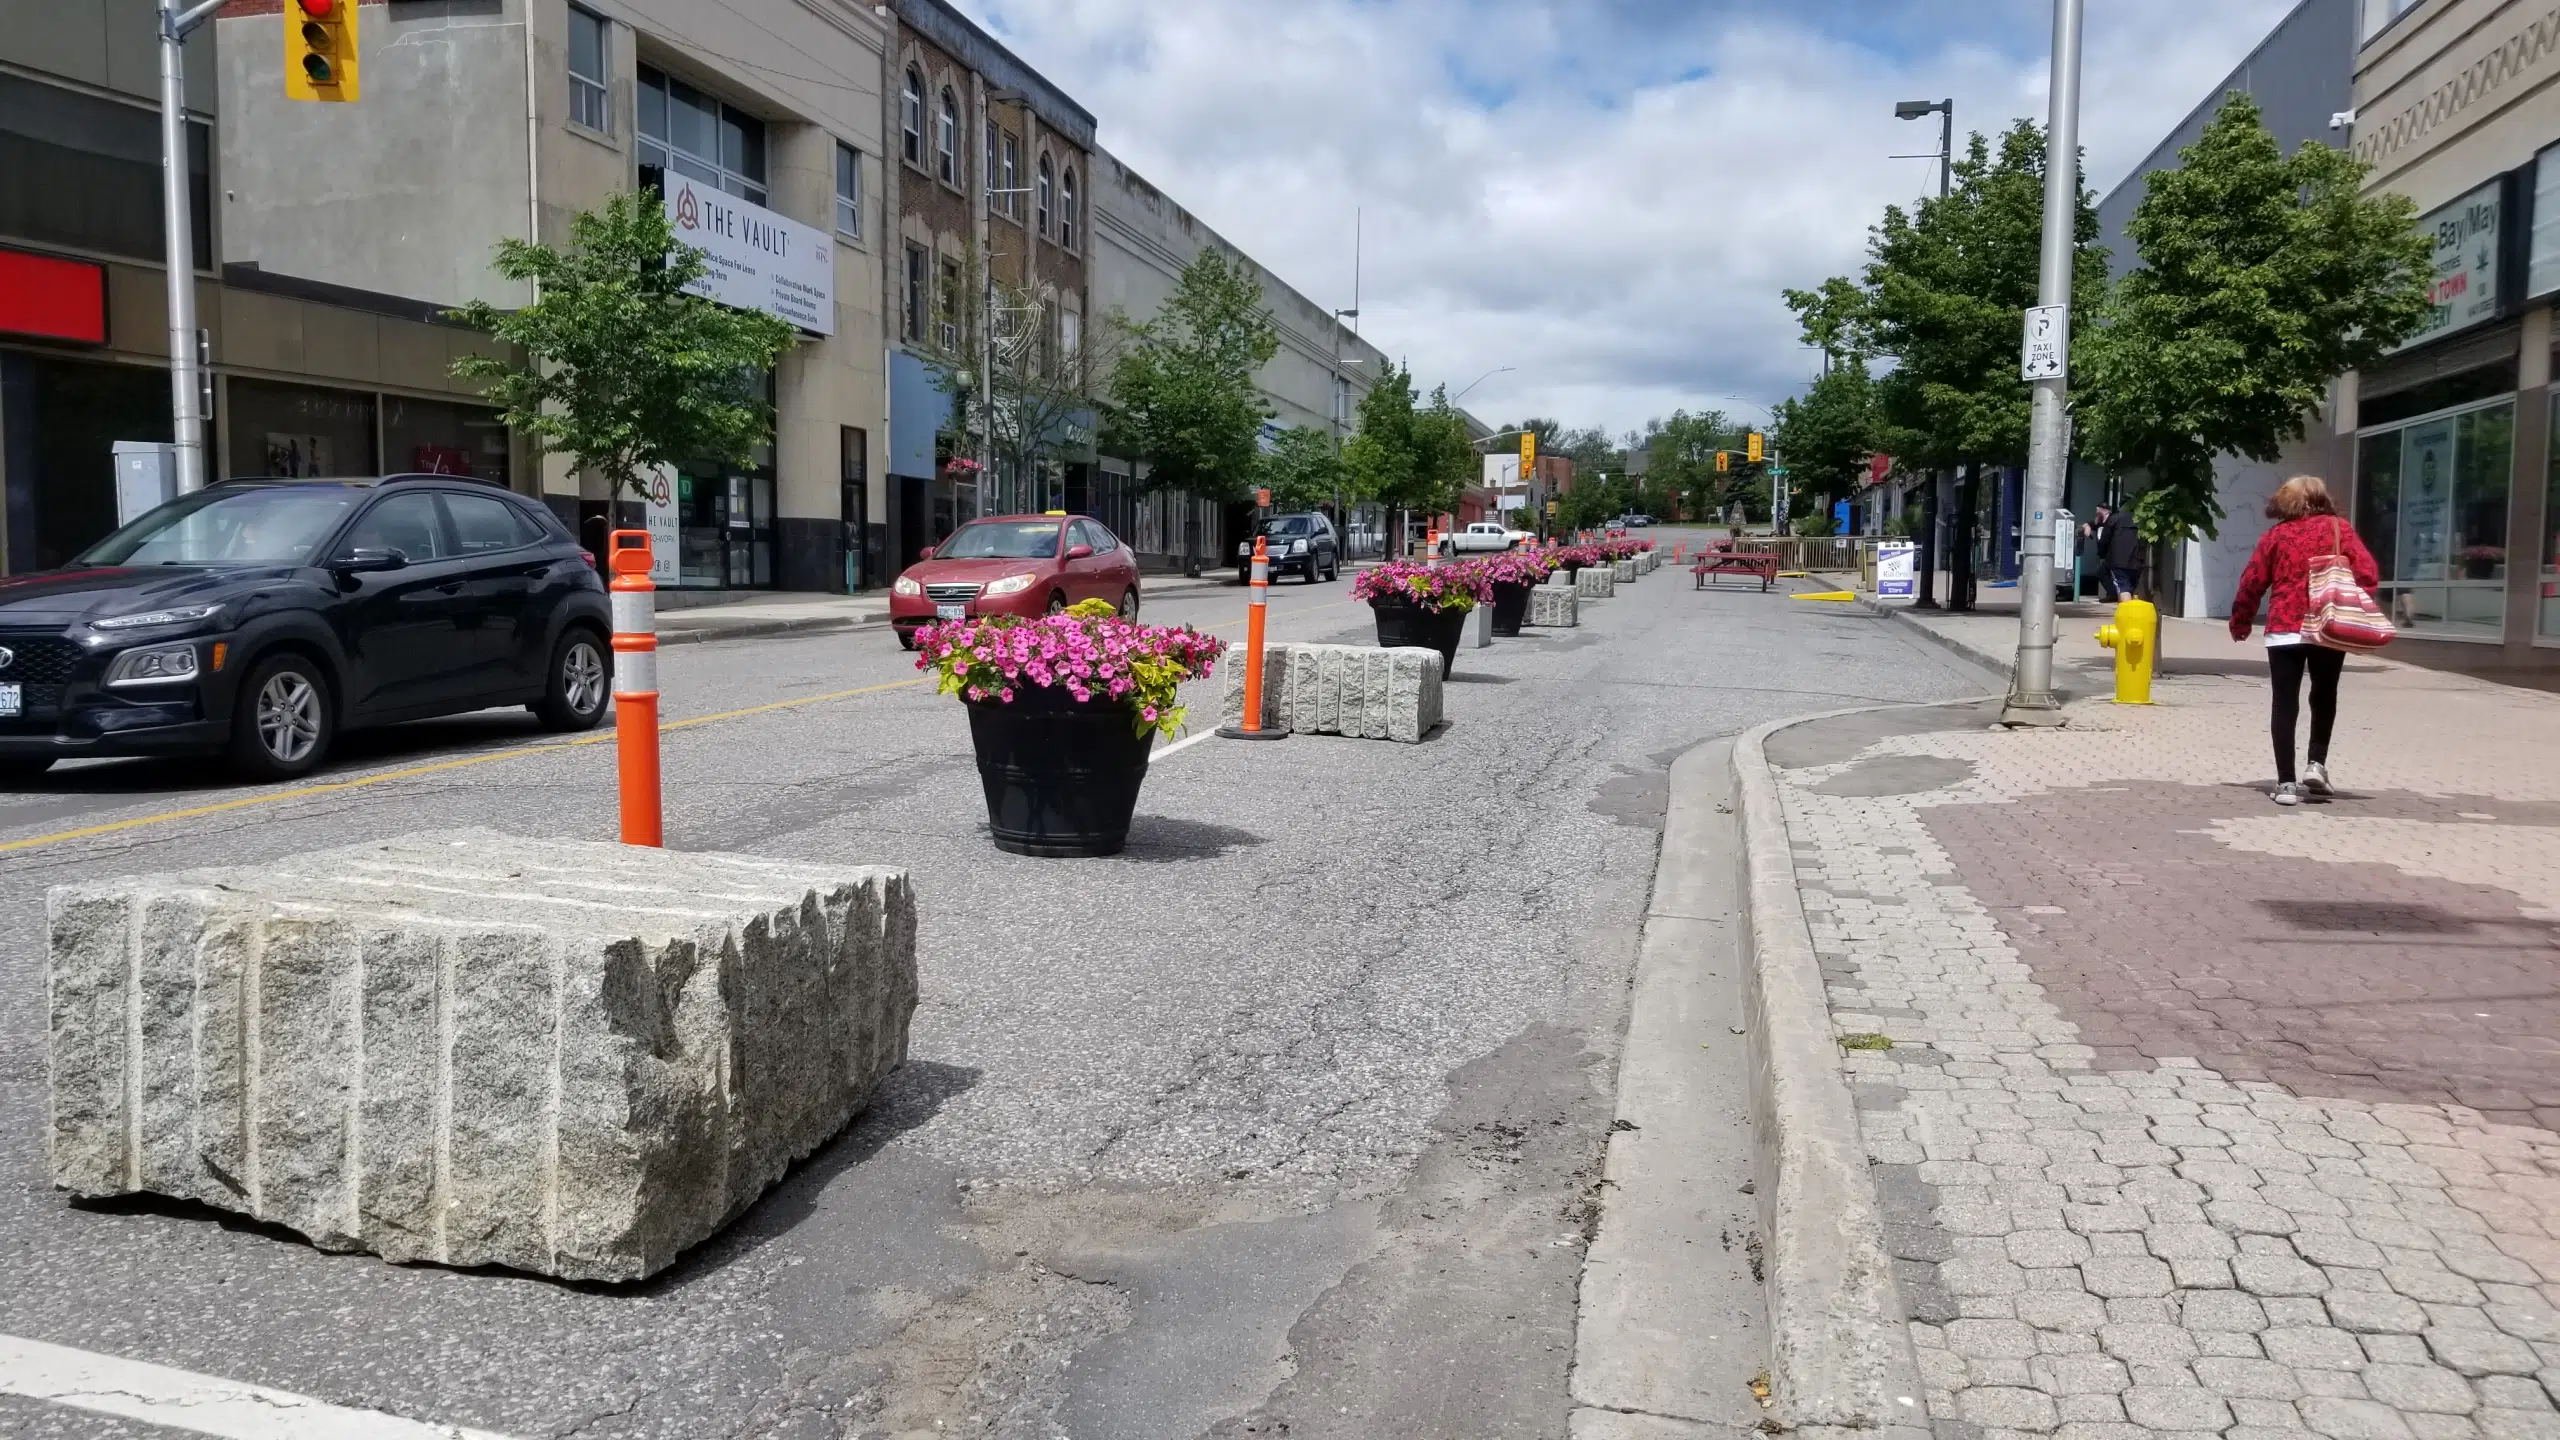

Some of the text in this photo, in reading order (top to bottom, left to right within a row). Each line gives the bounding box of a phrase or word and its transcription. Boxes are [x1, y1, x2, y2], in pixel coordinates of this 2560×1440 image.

[705, 201, 787, 258] THE VAULT
[2439, 201, 2500, 251] Bay/May
[718, 254, 734, 268] Space
[734, 259, 742, 271] For
[742, 262, 756, 276] Lease
[701, 280, 712, 292] Gym
[2438, 271, 2467, 302] TOWN
[775, 288, 790, 302] Private
[813, 287, 826, 300] Space
[2033, 343, 2052, 352] TAXI
[2032, 352, 2054, 361] ZONE
[660, 517, 678, 528] VAULT
[1, 691, 20, 709] 672
